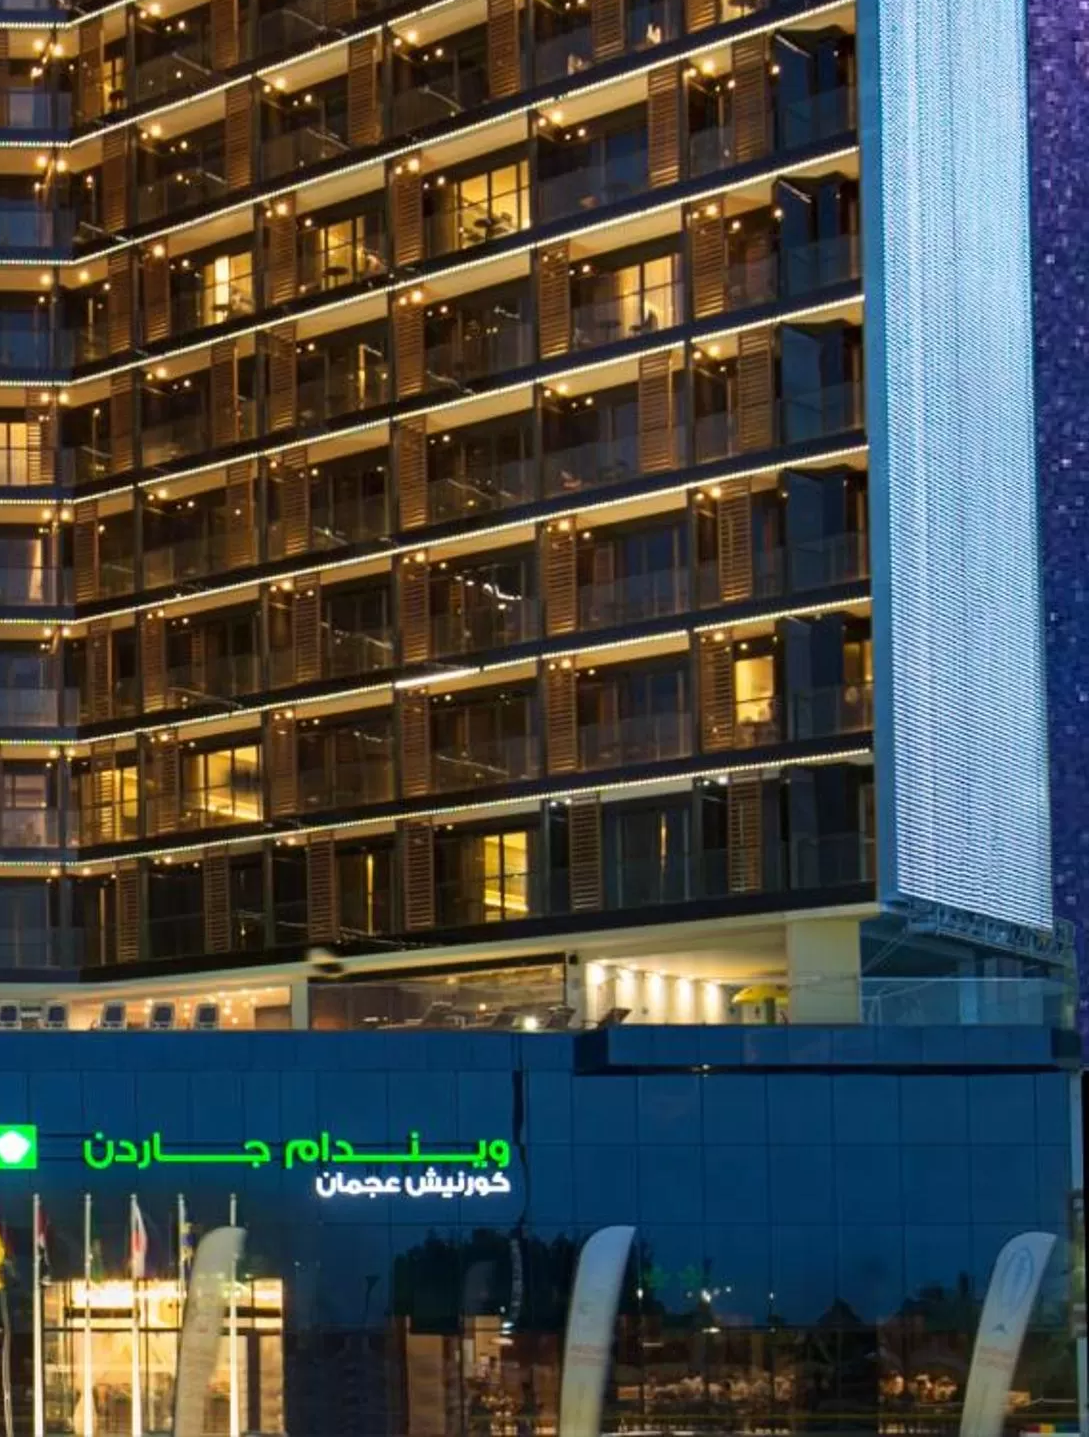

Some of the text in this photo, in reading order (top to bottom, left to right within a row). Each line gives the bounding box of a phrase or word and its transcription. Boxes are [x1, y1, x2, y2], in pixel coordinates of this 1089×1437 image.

[84, 1132, 271, 1169] جاردن
[315, 1166, 511, 1199] كورنيش عجمان
